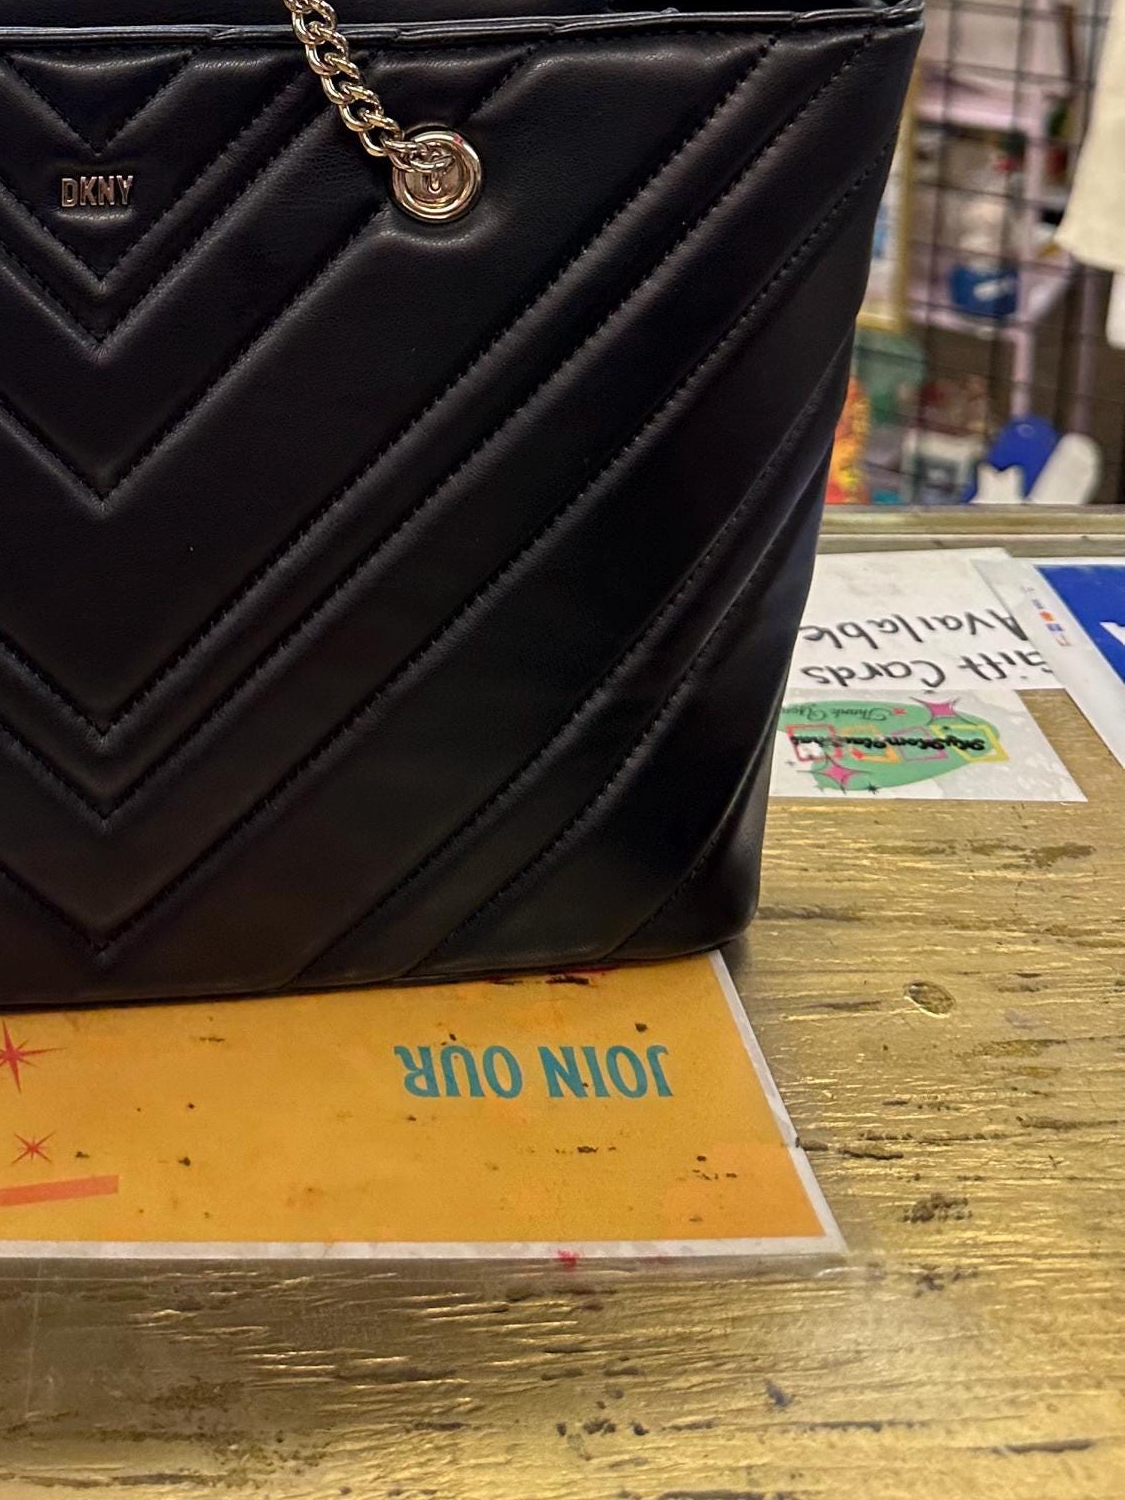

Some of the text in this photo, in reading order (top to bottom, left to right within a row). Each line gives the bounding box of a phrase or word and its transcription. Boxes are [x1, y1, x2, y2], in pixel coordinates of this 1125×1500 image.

[61, 175, 134, 207] DKNY
[799, 608, 1029, 650] Available
[800, 660, 946, 688] Cards
[393, 1044, 674, 1100] JOIN OUR
